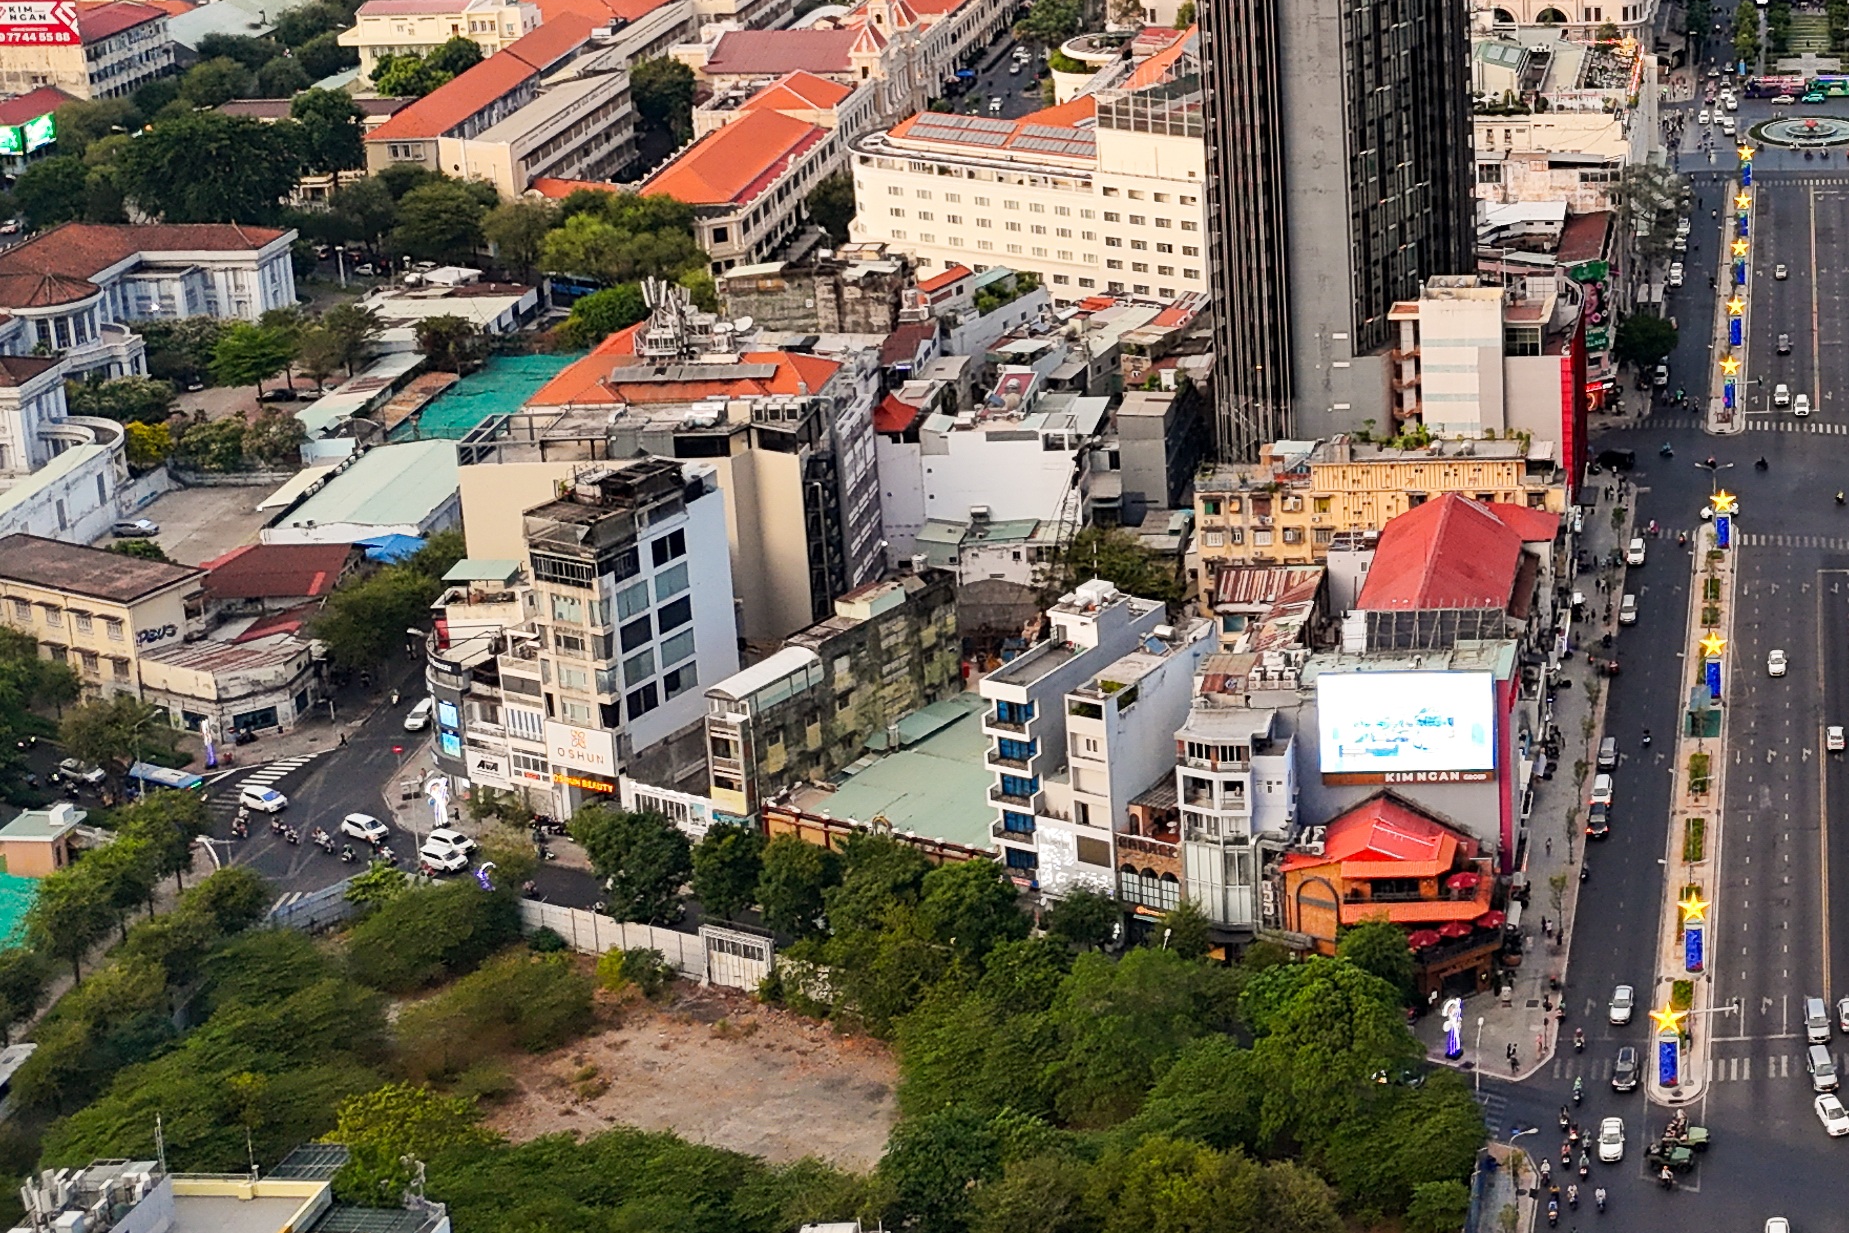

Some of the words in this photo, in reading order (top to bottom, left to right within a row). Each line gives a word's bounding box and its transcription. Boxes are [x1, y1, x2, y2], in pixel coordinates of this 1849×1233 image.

[557, 747, 604, 764] OSHUN
[1385, 772, 1414, 782] KIM
[1416, 771, 1460, 781] NGAN
